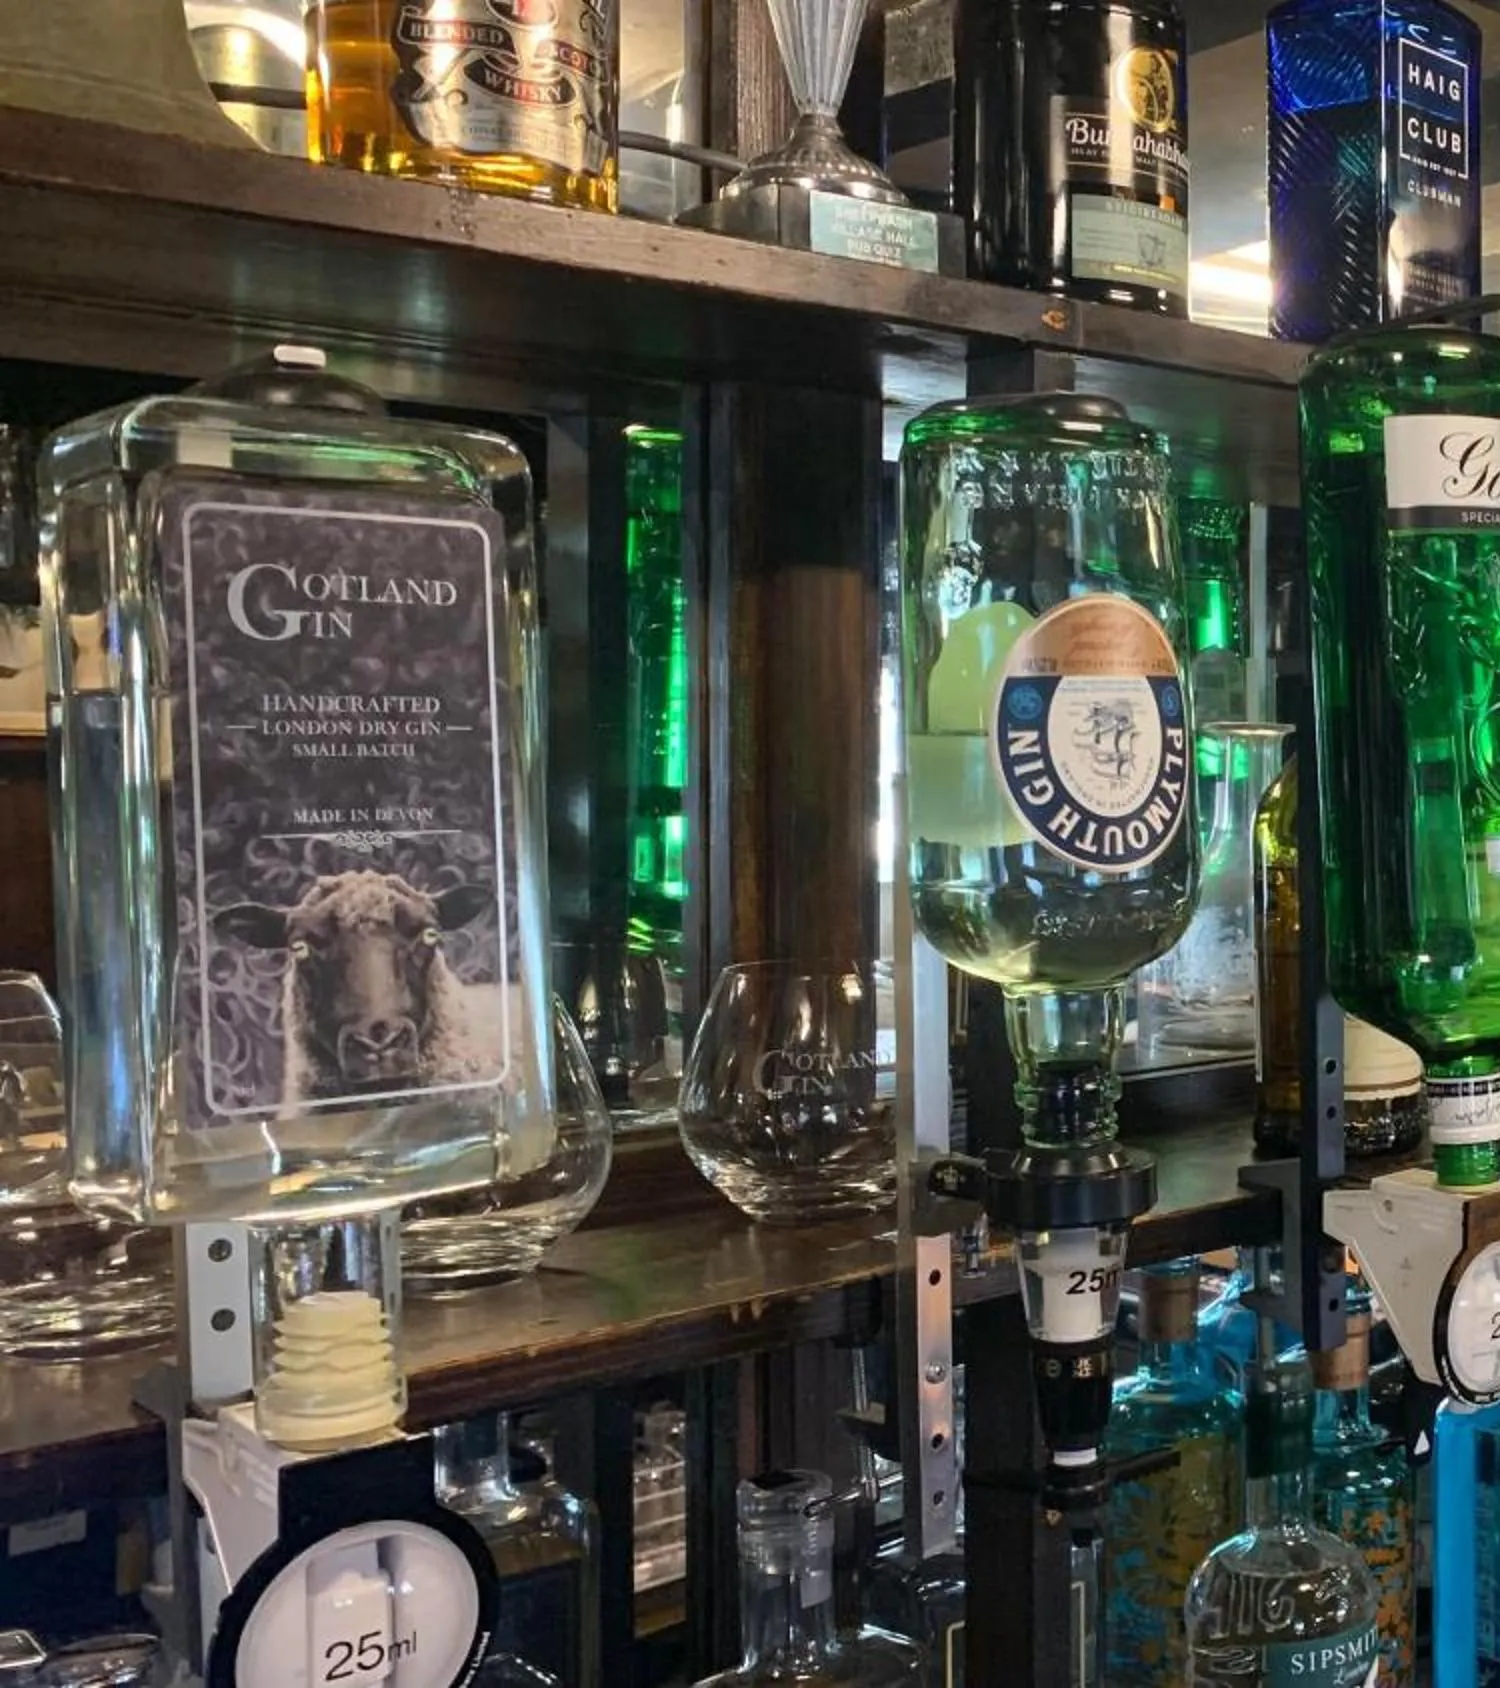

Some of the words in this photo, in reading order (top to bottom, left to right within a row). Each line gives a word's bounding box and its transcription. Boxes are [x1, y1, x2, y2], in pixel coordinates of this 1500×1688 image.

[409, 21, 505, 45] BLENDED
[482, 68, 564, 101] WHISKY
[1407, 62, 1462, 101] HAIG
[1406, 116, 1462, 154] CLUB
[1406, 179, 1462, 208] CLUBMAN
[227, 563, 458, 641] GOTLAND
[261, 693, 442, 714] HANDCRAFTED
[261, 719, 354, 737] LONDON
[358, 719, 400, 737] DRY
[404, 720, 442, 737] GIN
[291, 743, 353, 758] SMALL
[356, 743, 416, 758] BATCH
[1007, 729, 1057, 807] GIN
[1047, 726, 1186, 857] PLYMOUTH
[293, 807, 346, 824] MADE
[350, 807, 371, 823] IN
[374, 806, 435, 823] DEVON
[324, 1629, 418, 1682] 25ml
[1290, 1626, 1379, 1676] SIPSMIT
